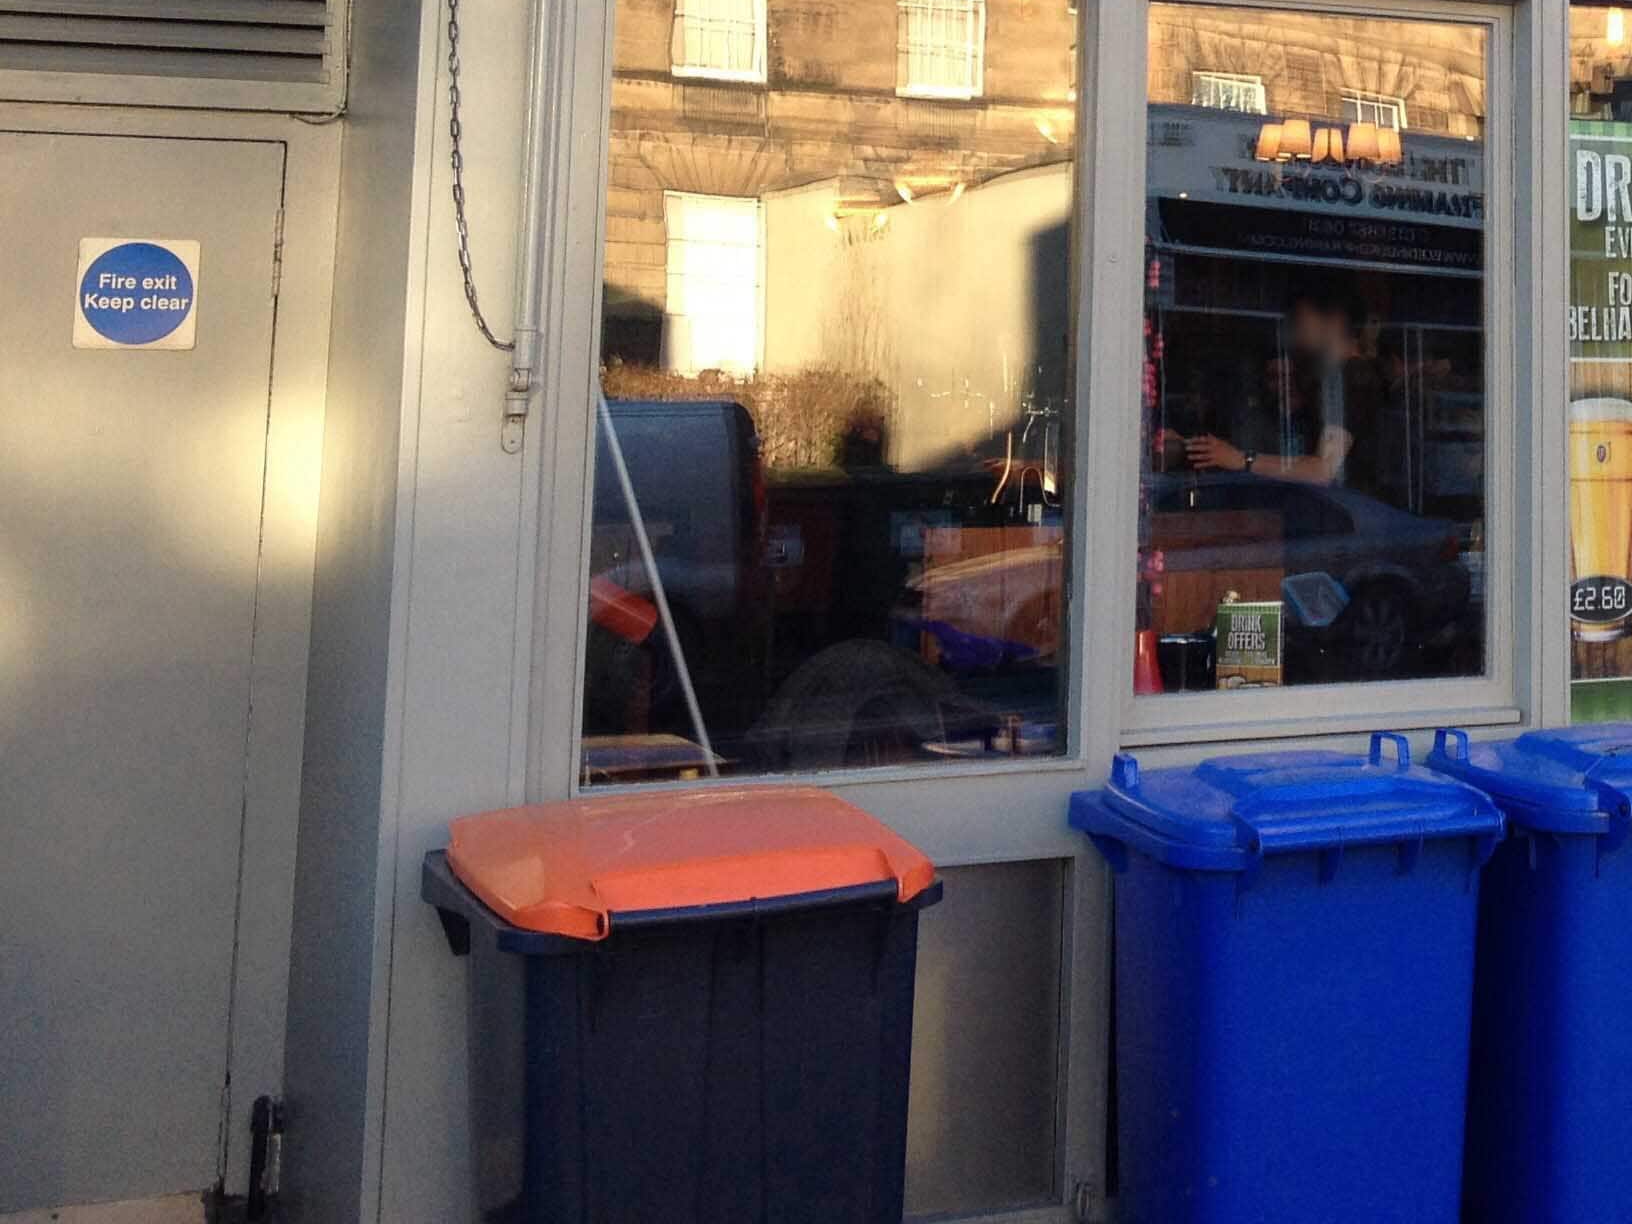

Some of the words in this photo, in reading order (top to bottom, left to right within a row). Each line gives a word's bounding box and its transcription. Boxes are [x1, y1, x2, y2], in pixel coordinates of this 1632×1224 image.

[99, 273, 136, 289] Fire
[142, 275, 177, 289] exit
[84, 293, 134, 312] Keep
[140, 294, 189, 310] clear
[1573, 586, 1625, 610] £2.60
[1231, 615, 1262, 633] DRINK
[1227, 632, 1265, 650] OFFERS
